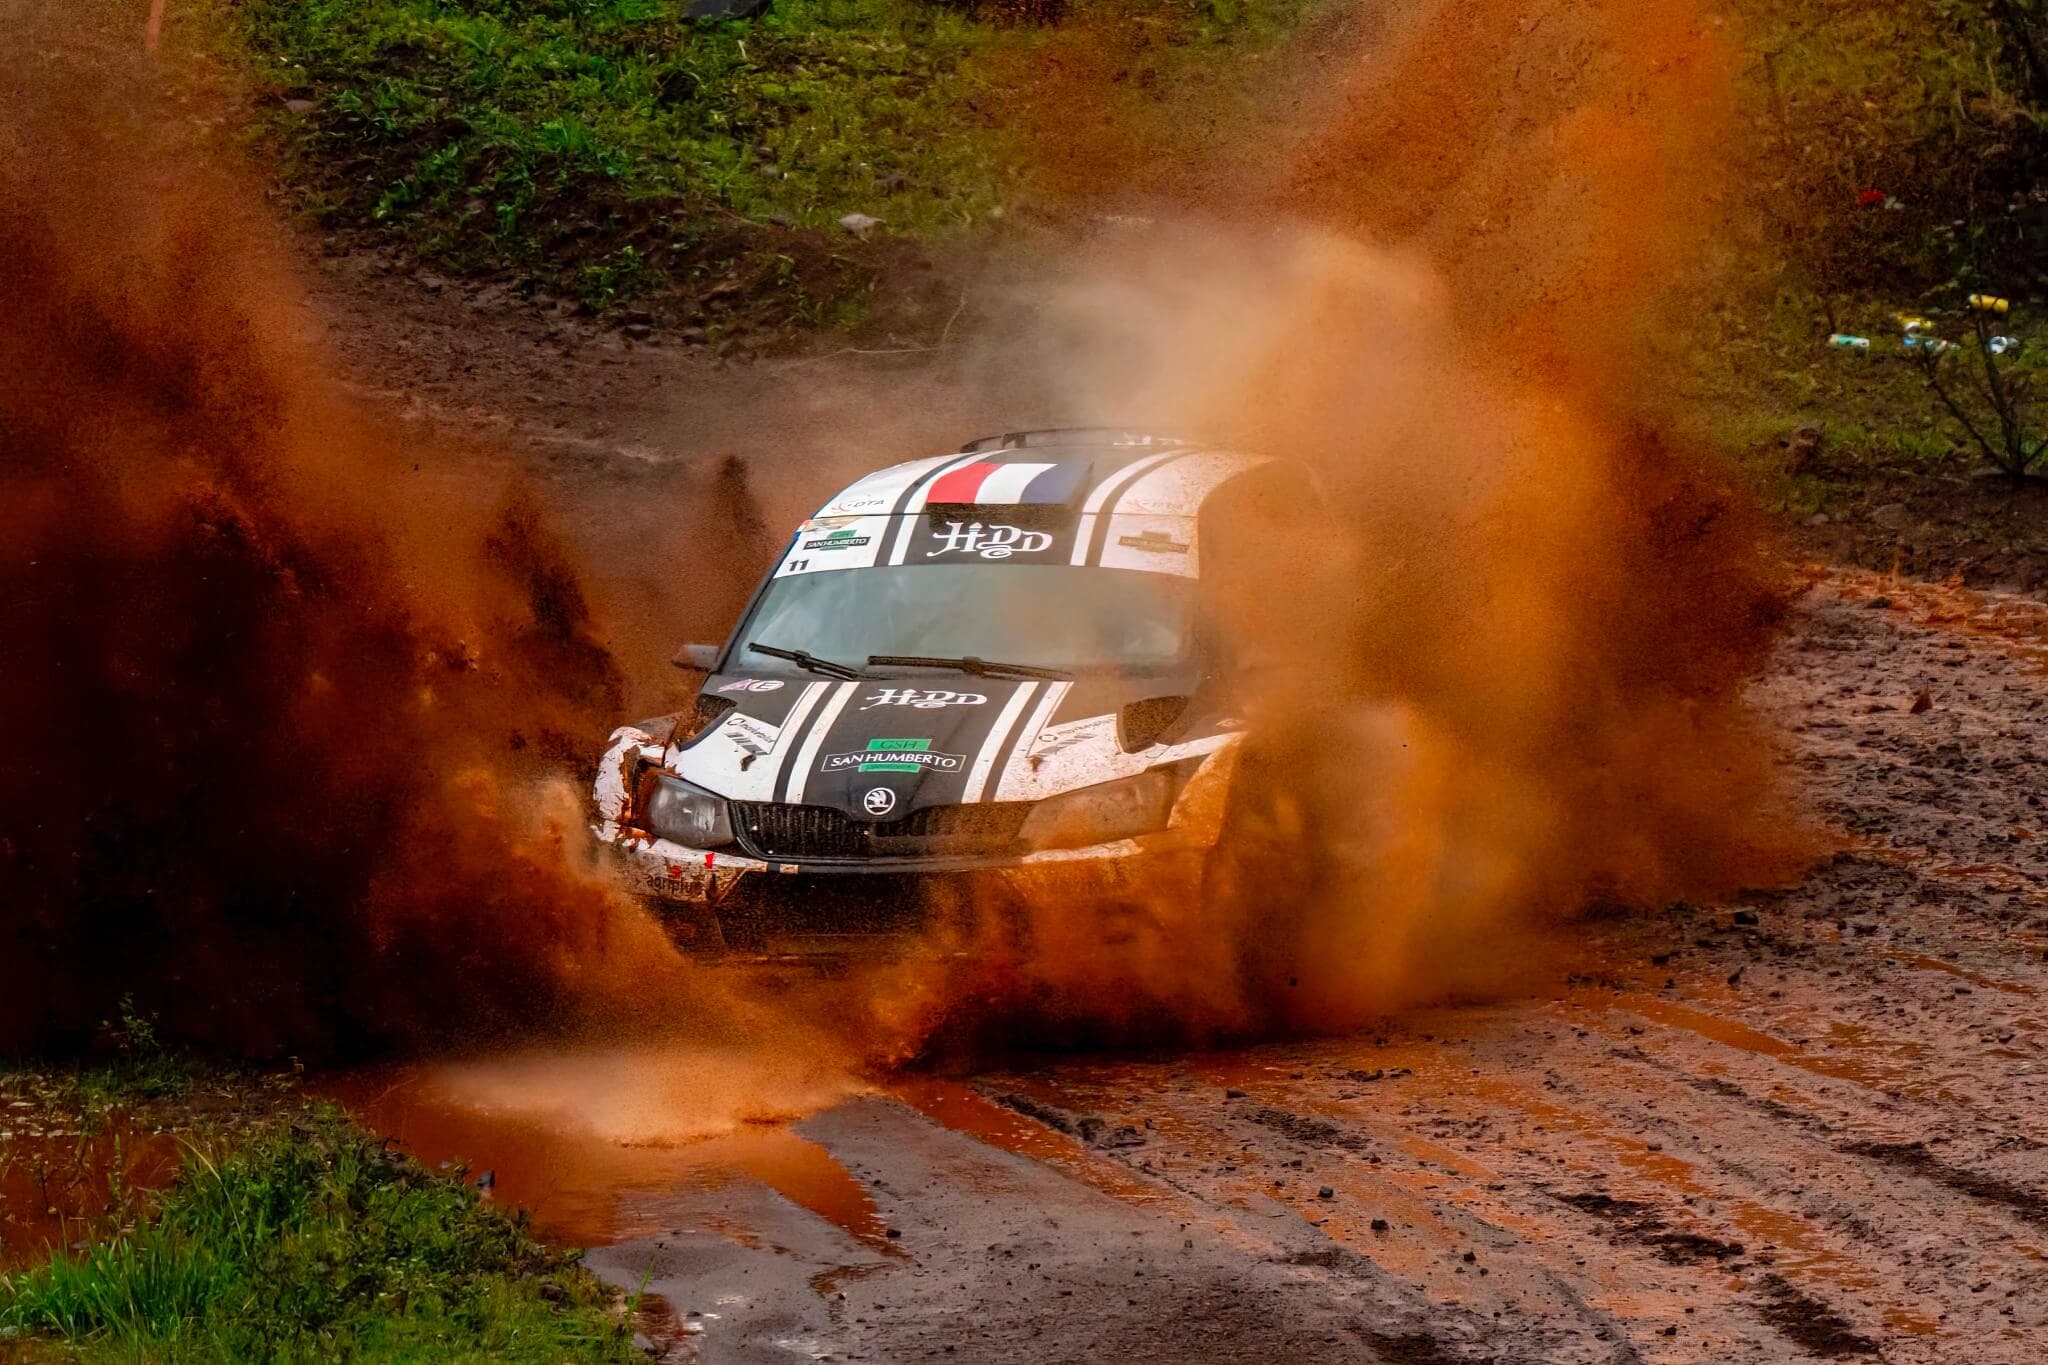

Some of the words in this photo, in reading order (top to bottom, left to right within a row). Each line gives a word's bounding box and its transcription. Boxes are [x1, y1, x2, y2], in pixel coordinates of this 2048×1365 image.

[788, 560, 809, 572] 11
[880, 740, 918, 750] GSH
[830, 753, 865, 767] SAN
[864, 753, 957, 768] HUMBERTO
